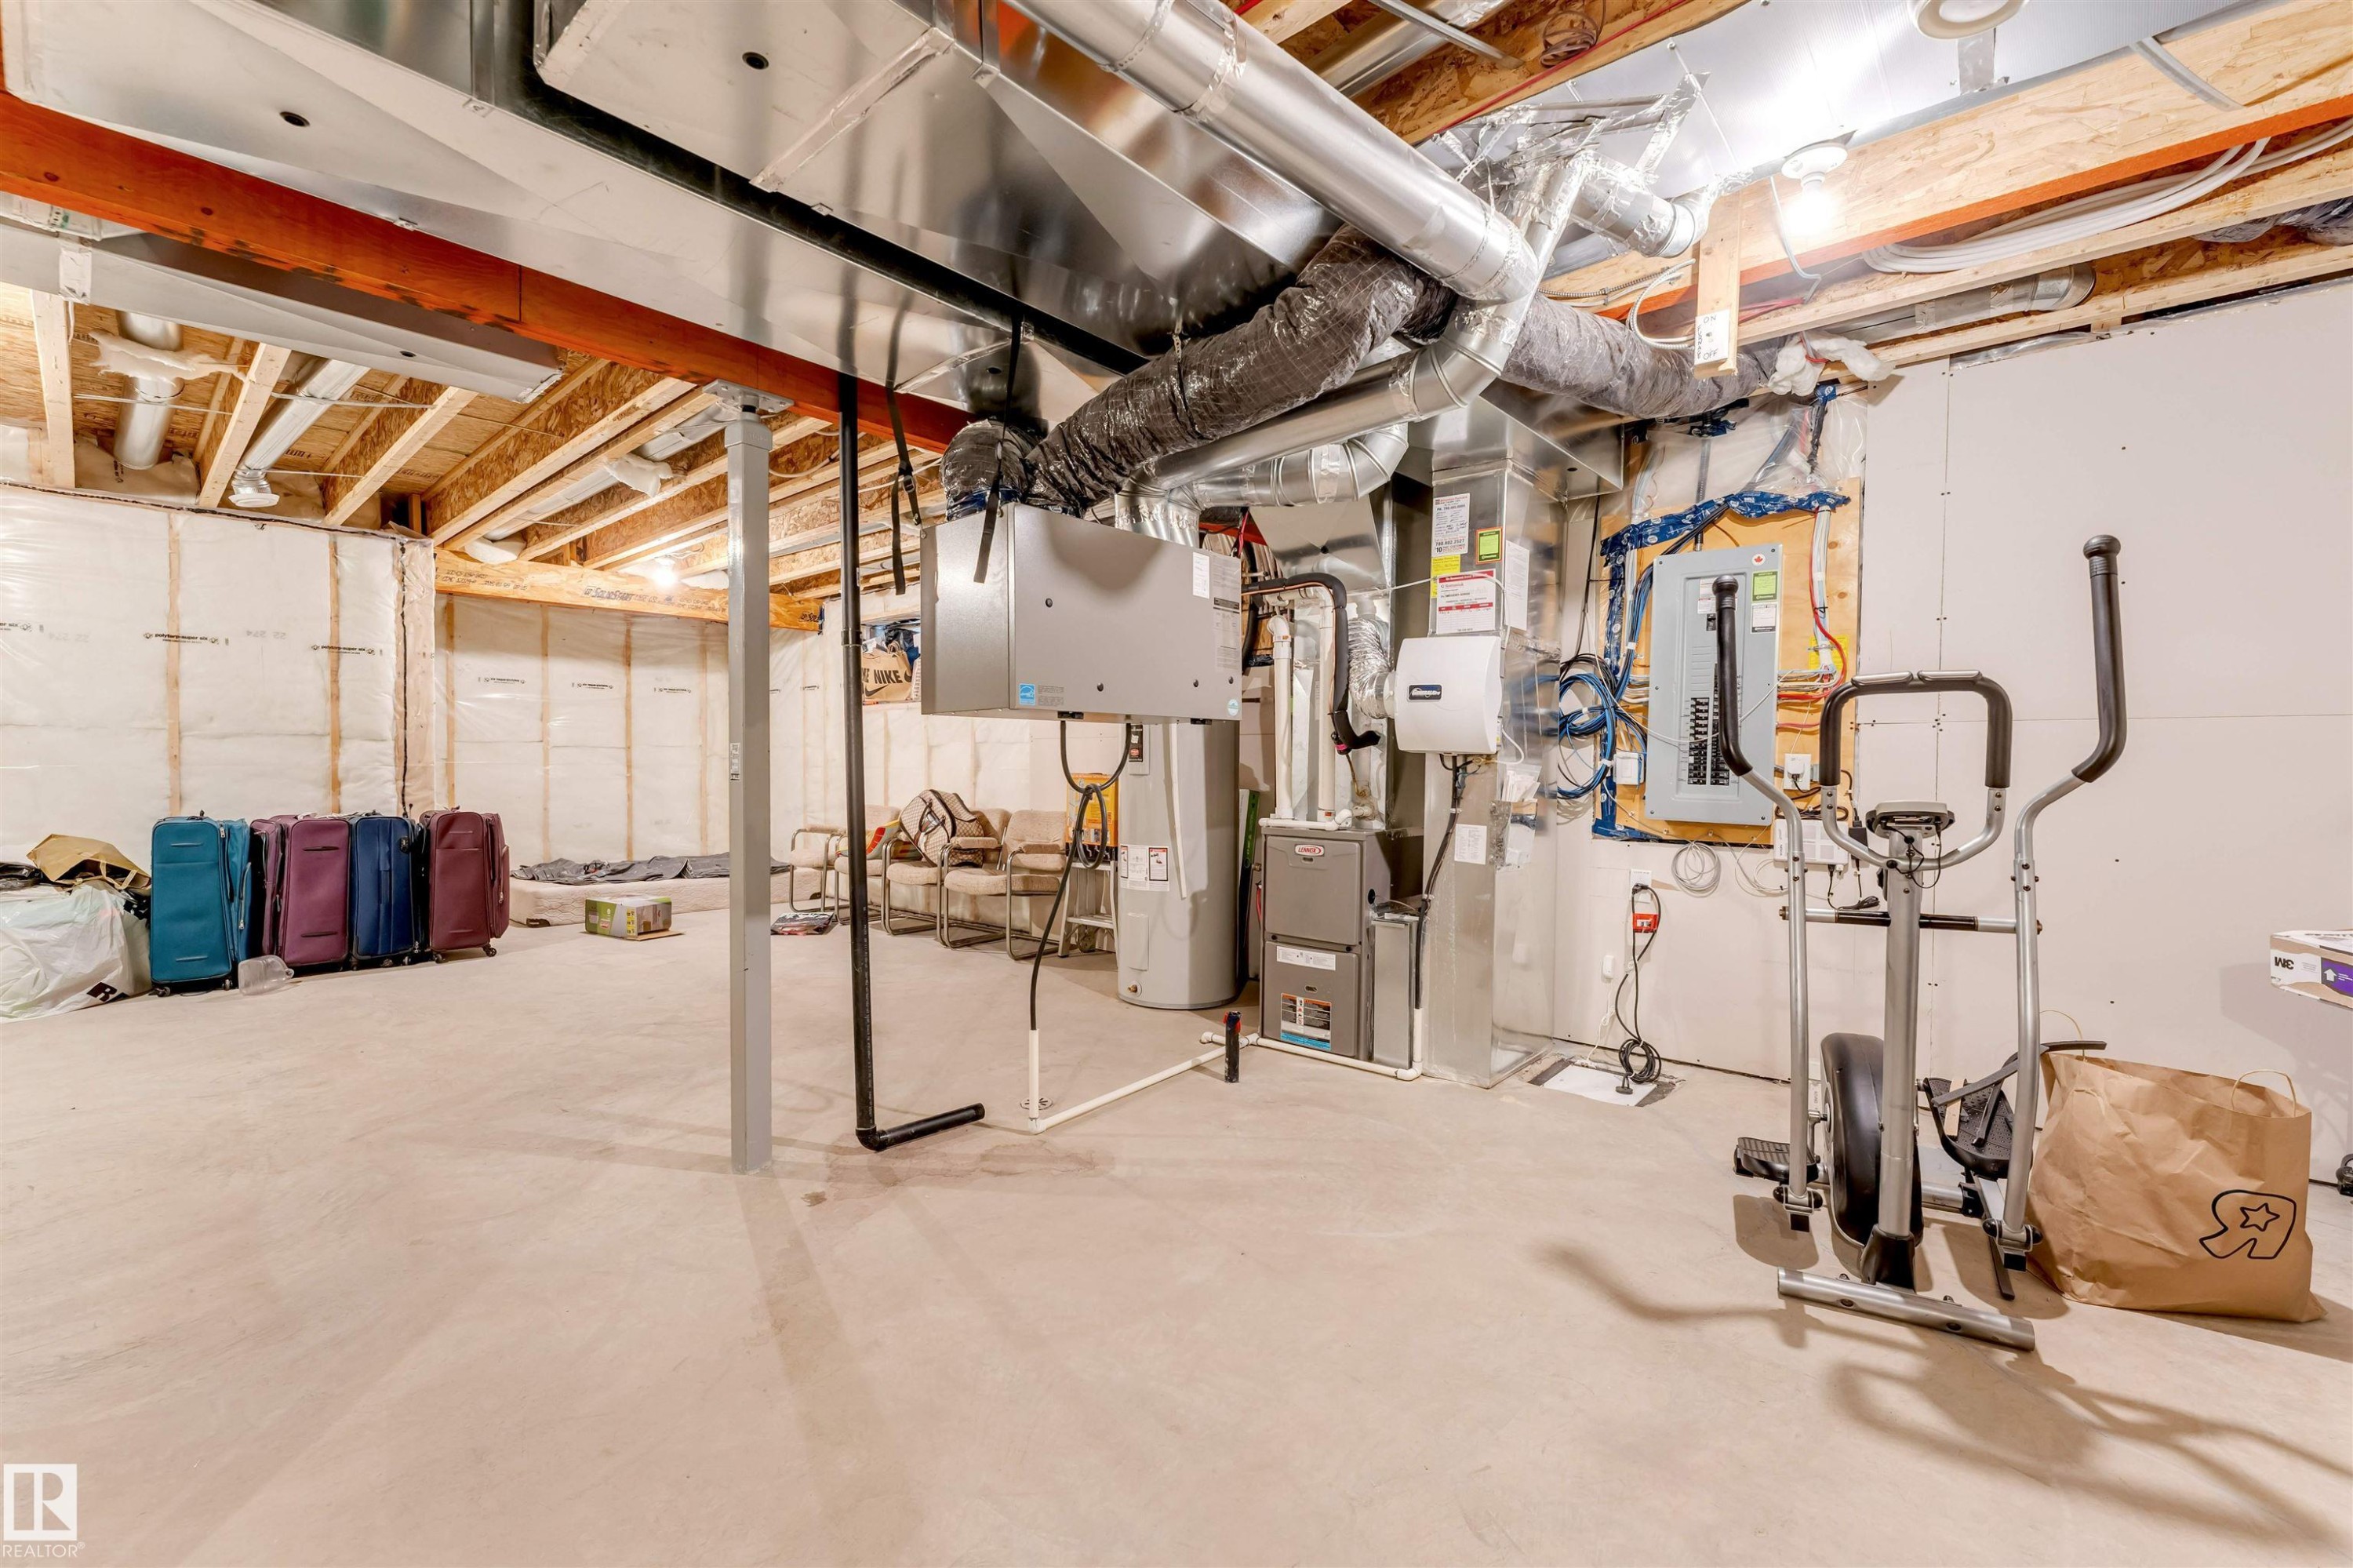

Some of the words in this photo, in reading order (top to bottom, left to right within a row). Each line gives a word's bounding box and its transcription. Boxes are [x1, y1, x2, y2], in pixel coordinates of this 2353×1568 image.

[1704, 314, 1717, 323] ON
[1704, 347, 1718, 360] OFF
[873, 669, 903, 684] NIKE
